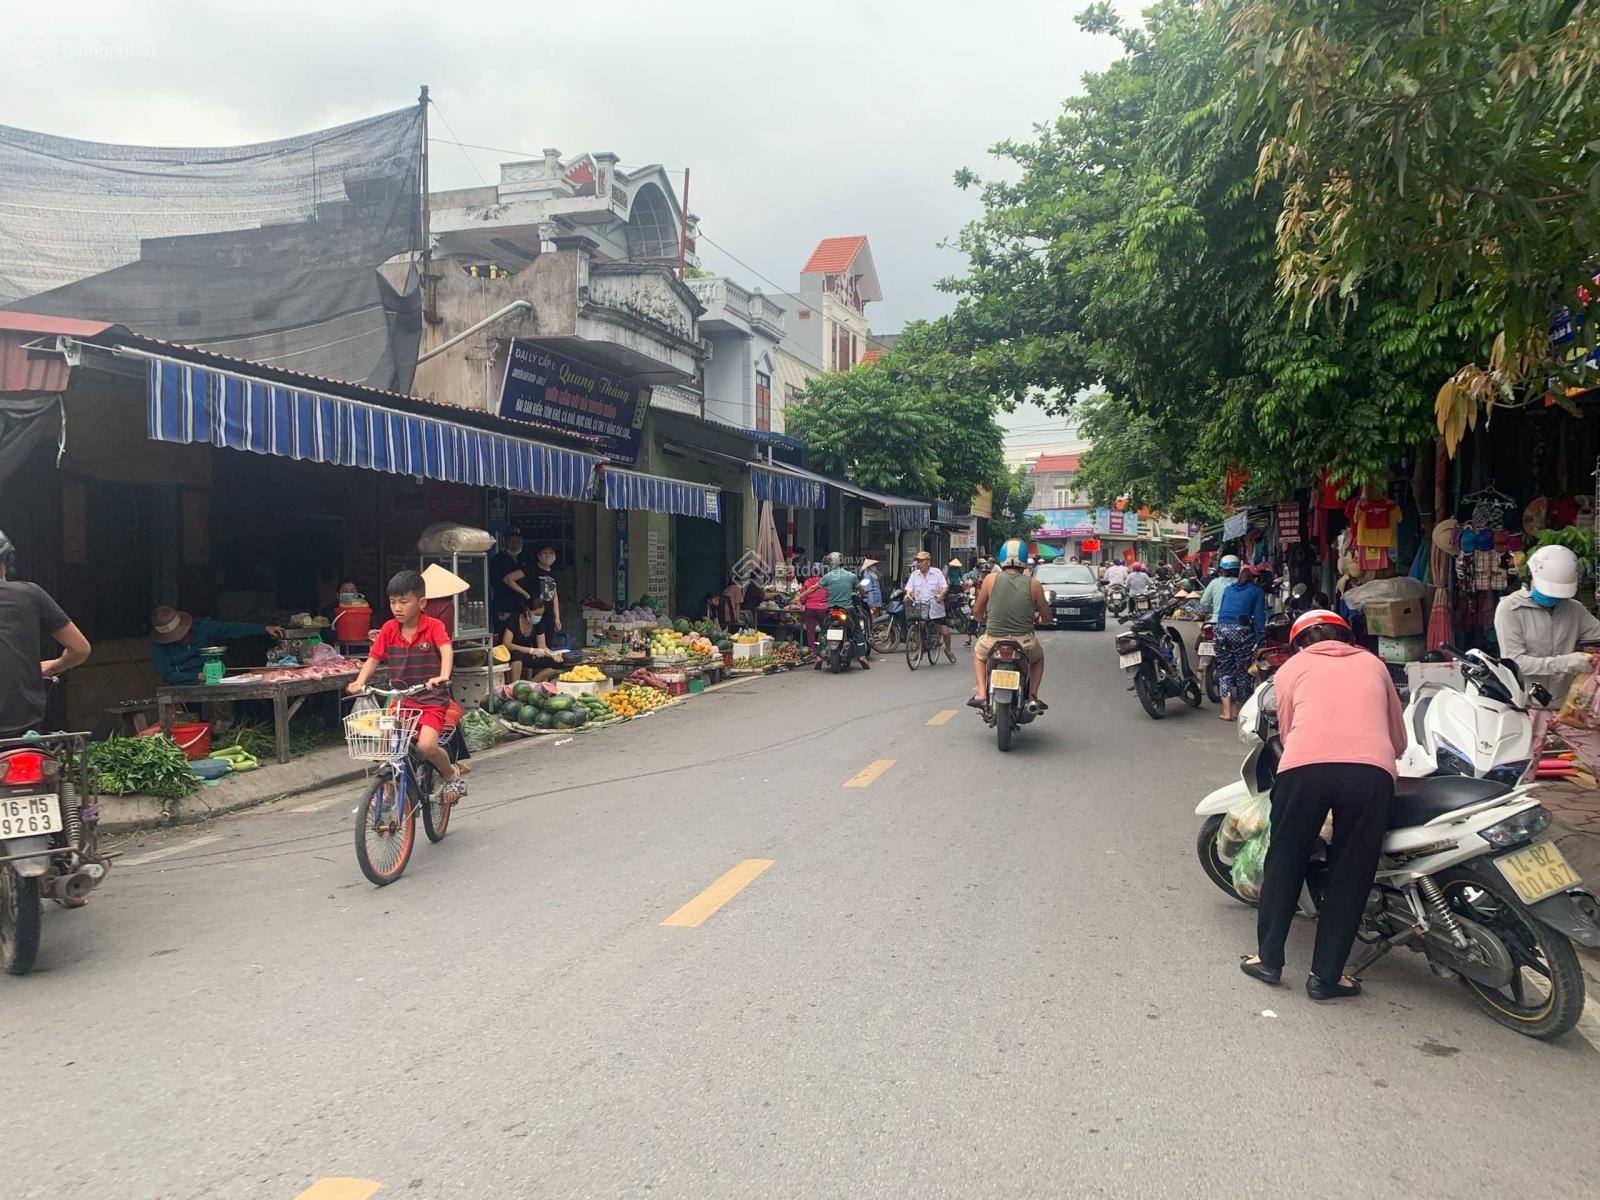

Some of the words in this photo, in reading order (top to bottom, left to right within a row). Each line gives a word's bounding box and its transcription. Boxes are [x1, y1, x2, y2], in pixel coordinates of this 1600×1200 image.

[515, 347, 528, 362] ĐẠI
[1, 797, 49, 817] 16-M5
[2, 815, 51, 835] 9263
[1507, 846, 1555, 876] 14-B2
